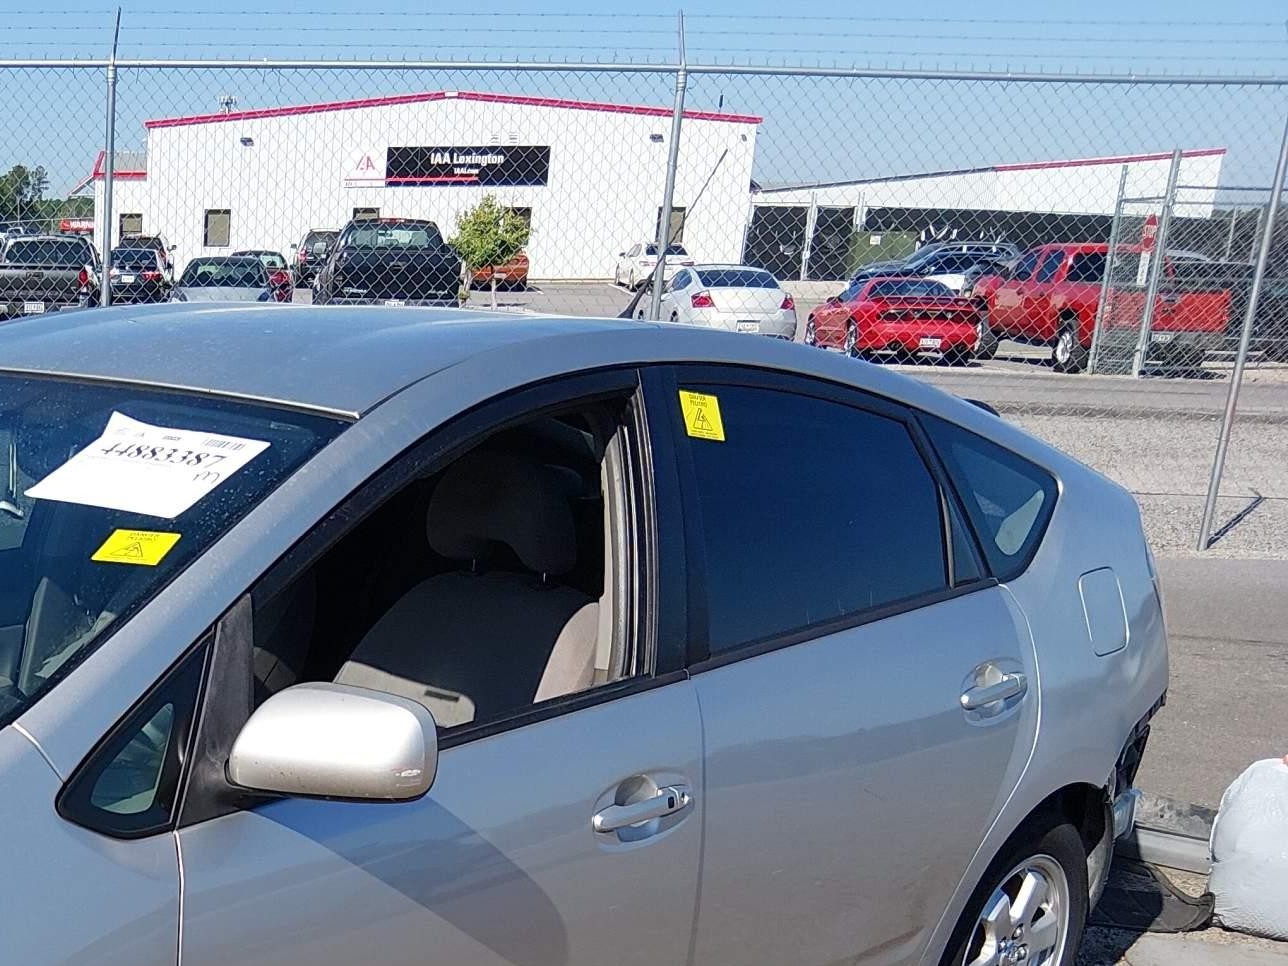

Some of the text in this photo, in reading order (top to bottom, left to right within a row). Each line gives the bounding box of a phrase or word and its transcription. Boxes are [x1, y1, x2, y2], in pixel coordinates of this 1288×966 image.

[430, 152, 505, 167] IAA Lexington
[101, 442, 227, 468] 44883387
